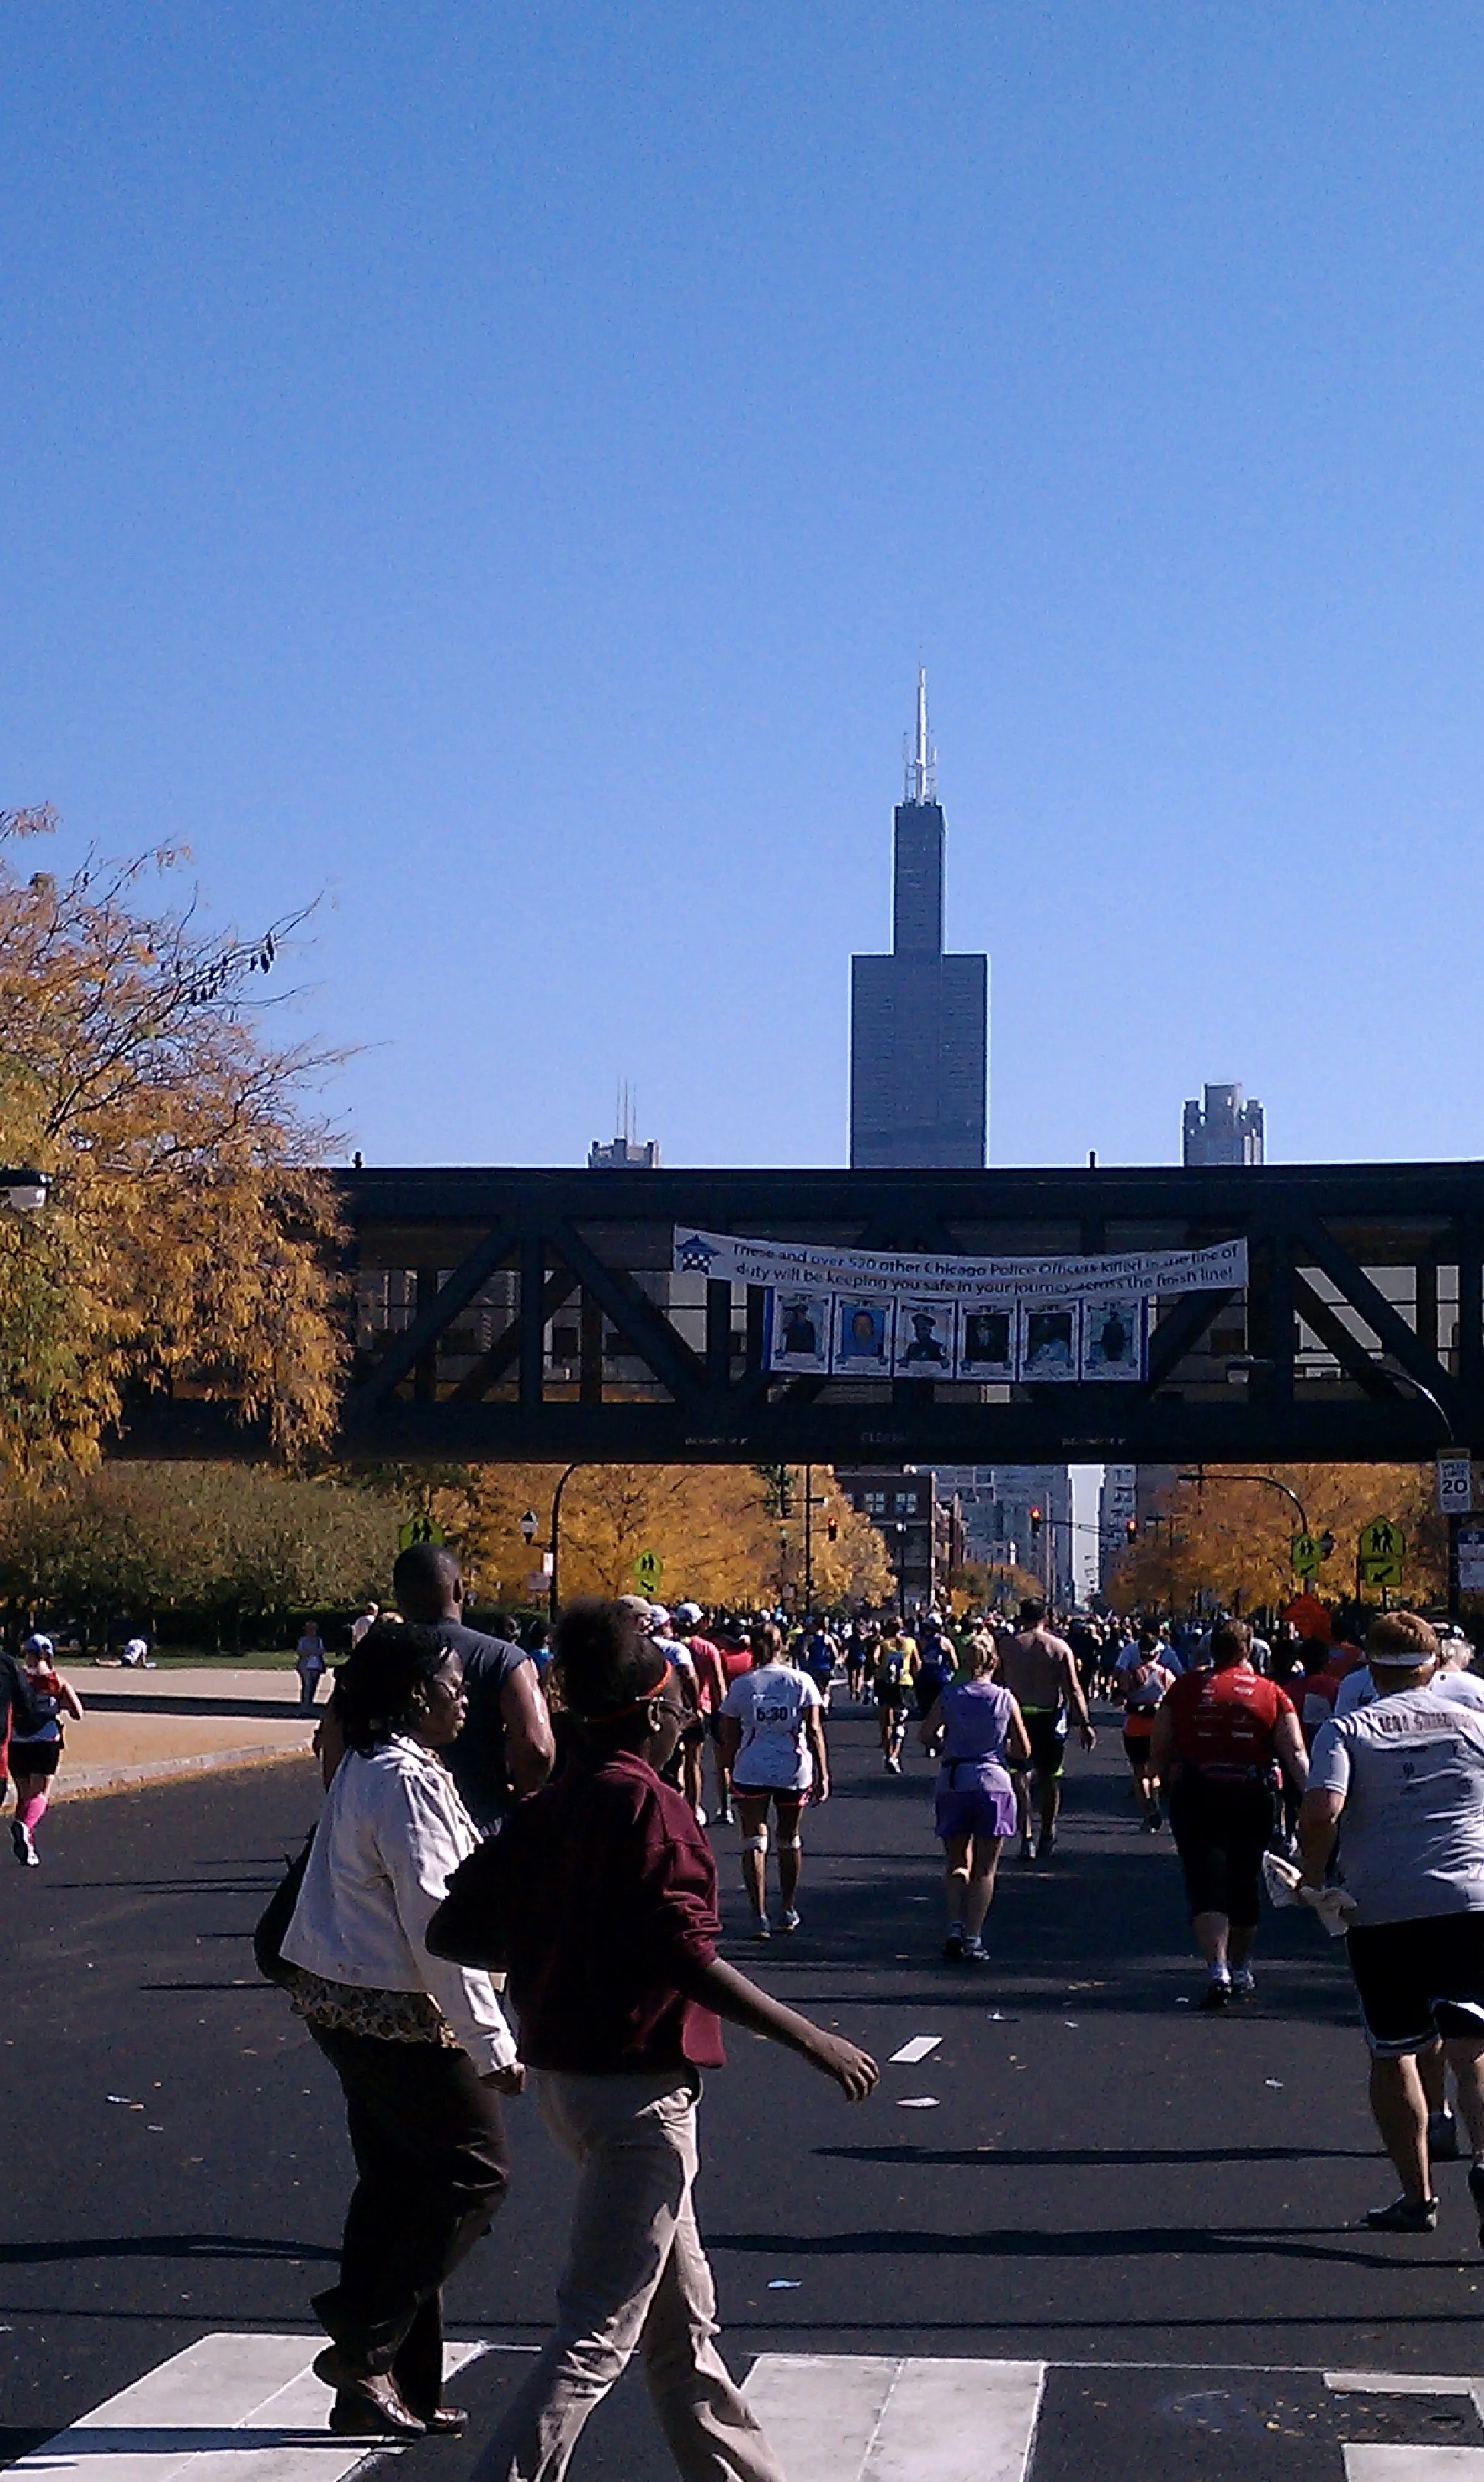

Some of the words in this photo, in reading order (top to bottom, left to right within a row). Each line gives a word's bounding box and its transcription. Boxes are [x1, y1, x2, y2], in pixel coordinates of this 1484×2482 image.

[780, 1252, 807, 1263] and
[811, 1255, 844, 1266] over
[880, 1259, 920, 1273] other
[925, 1262, 986, 1277] Chicago
[991, 1262, 1035, 1276] Police
[1102, 1259, 1140, 1273] killed
[1192, 1251, 1216, 1264] line
[1221, 1244, 1238, 1259] of
[736, 1262, 769, 1281] duty
[774, 1267, 800, 1282] will
[804, 1269, 823, 1283] be
[827, 1270, 887, 1290] keeping
[957, 1281, 972, 1292] in
[976, 1282, 1010, 1295] your
[1015, 1281, 1072, 1295] journey
[1127, 1274, 1153, 1288] the
[1156, 1270, 1197, 1287] finish
[1442, 1479, 1468, 1495] 20
